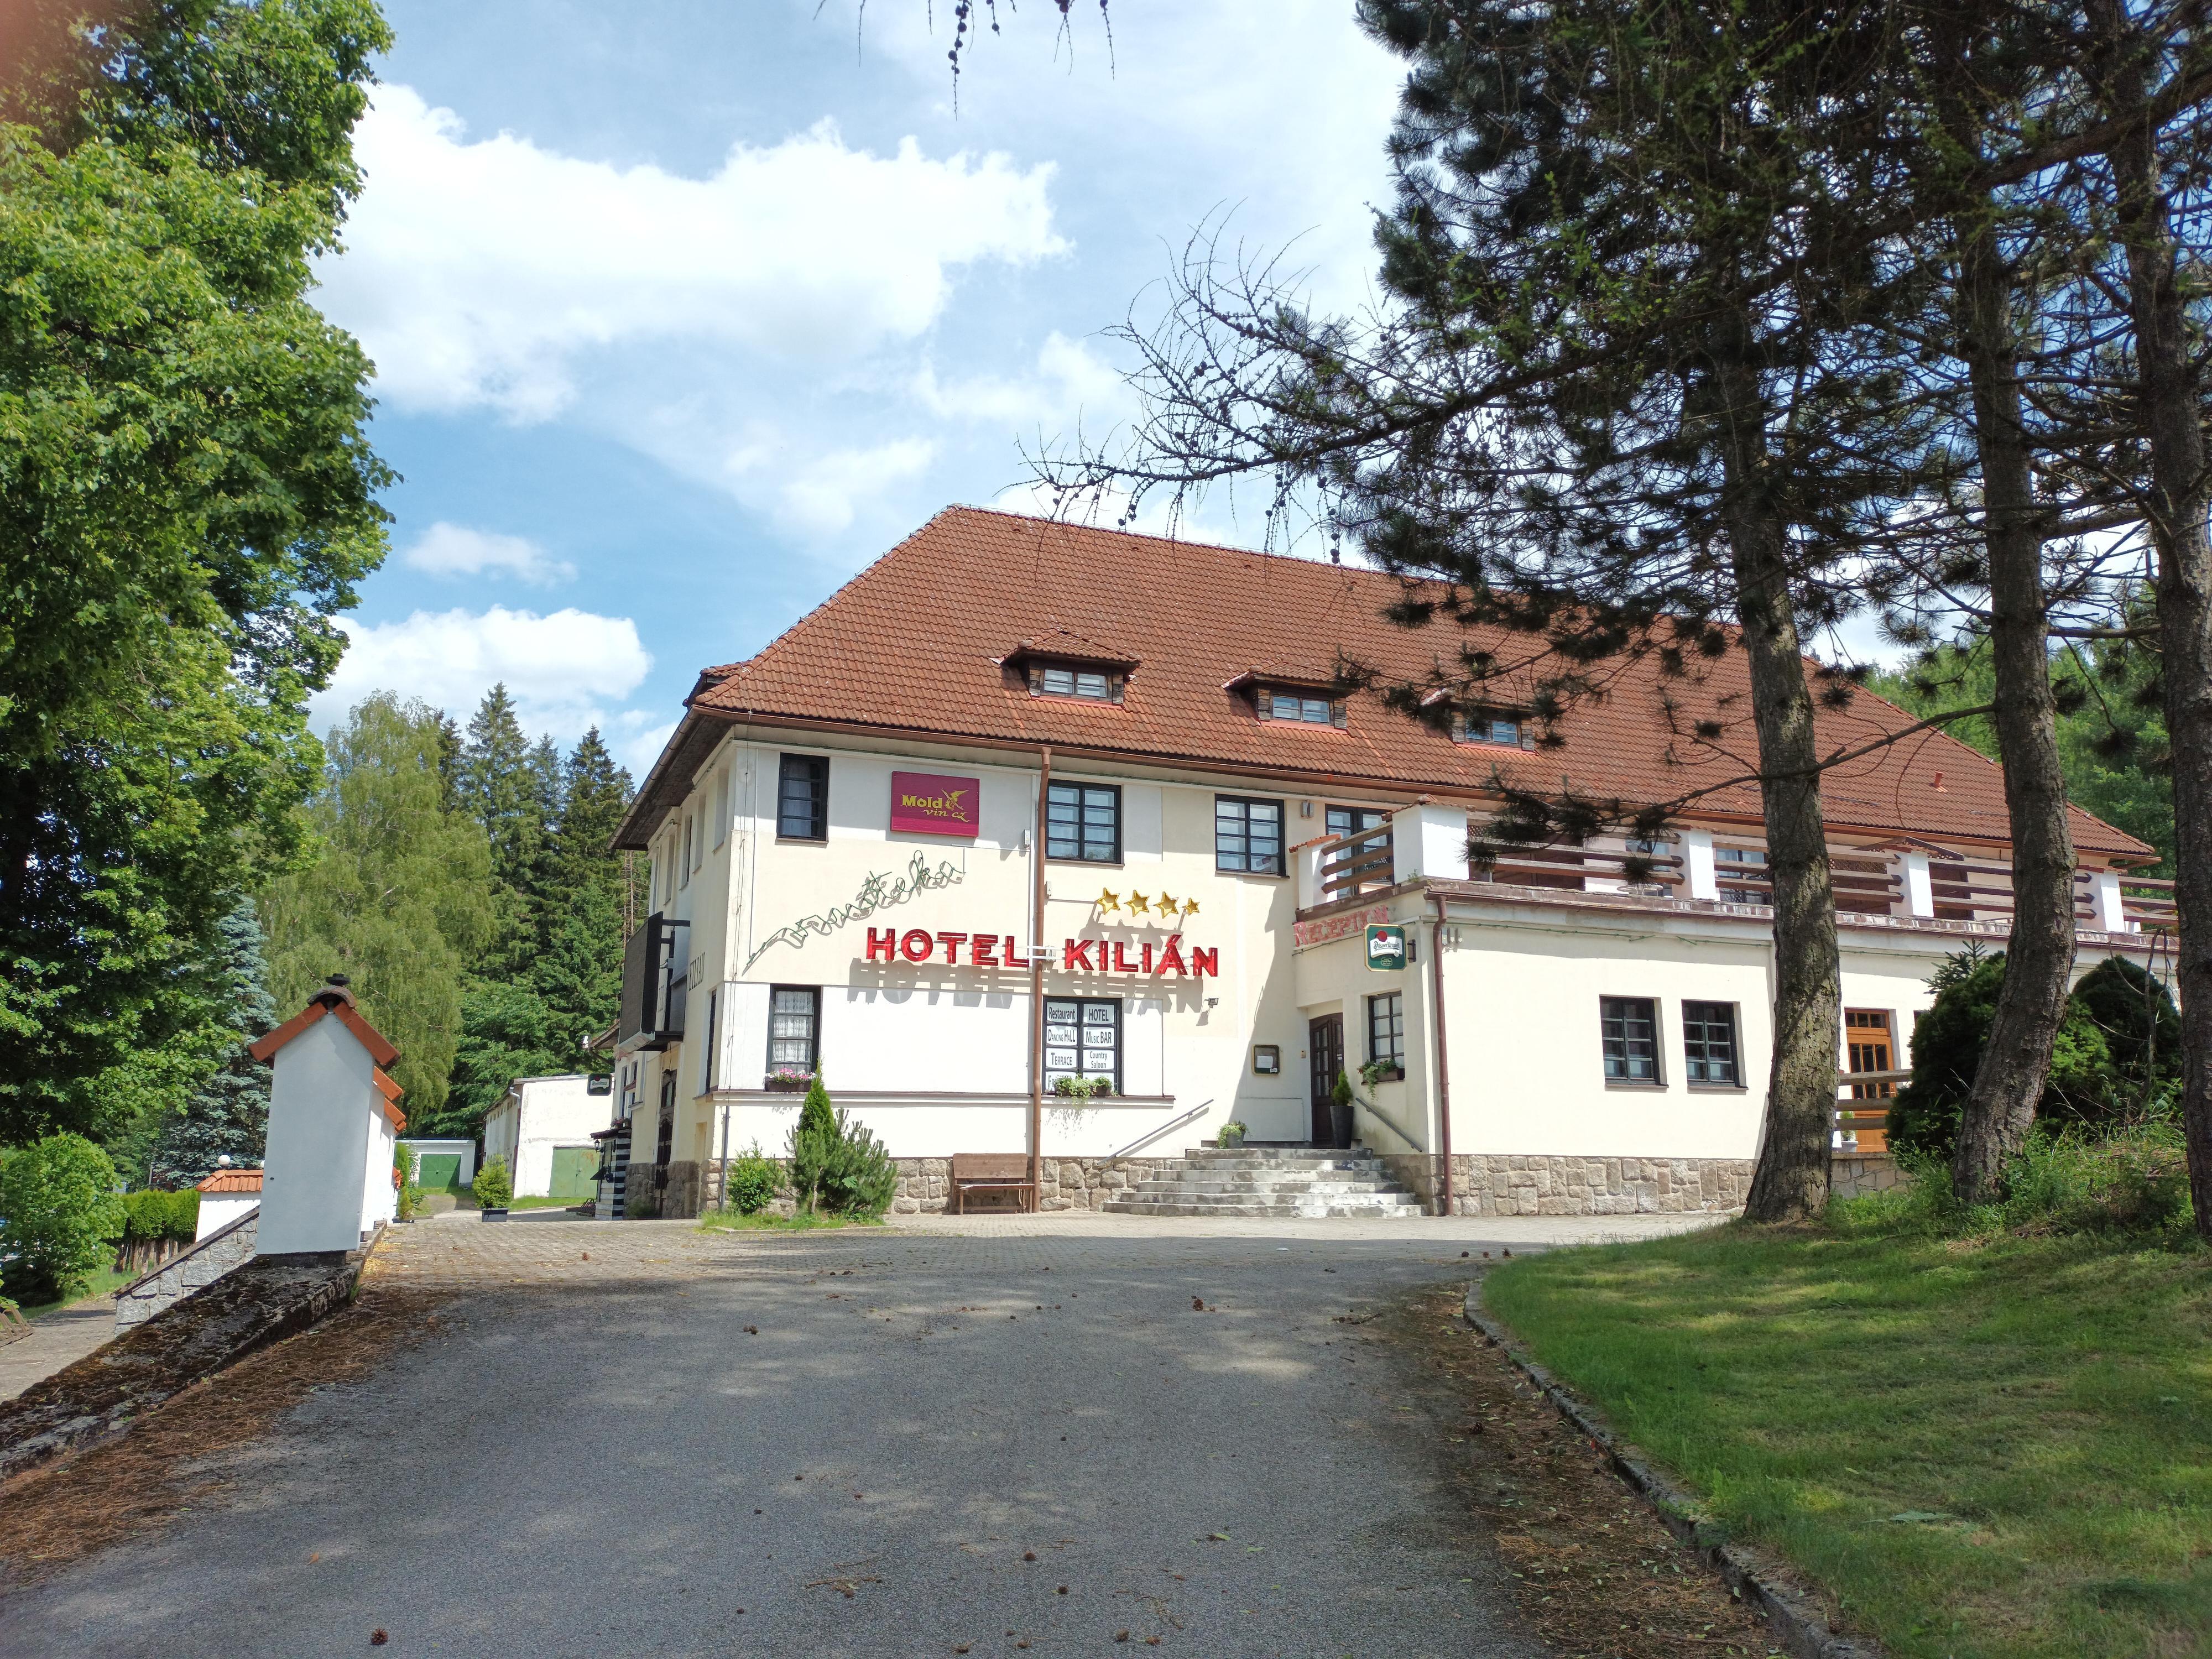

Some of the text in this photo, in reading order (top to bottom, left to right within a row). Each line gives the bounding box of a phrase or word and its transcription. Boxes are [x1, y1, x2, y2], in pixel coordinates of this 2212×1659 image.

[901, 794, 943, 808] Mold
[1292, 905, 1389, 947] RECEPTION
[866, 927, 1218, 977] HOTEL KILIÁN
[1049, 1006, 1075, 1020] Restaurant
[1089, 1009, 1109, 1021] HOTEL
[1100, 1031, 1112, 1044] BAR
[1089, 1051, 1108, 1061] Country
